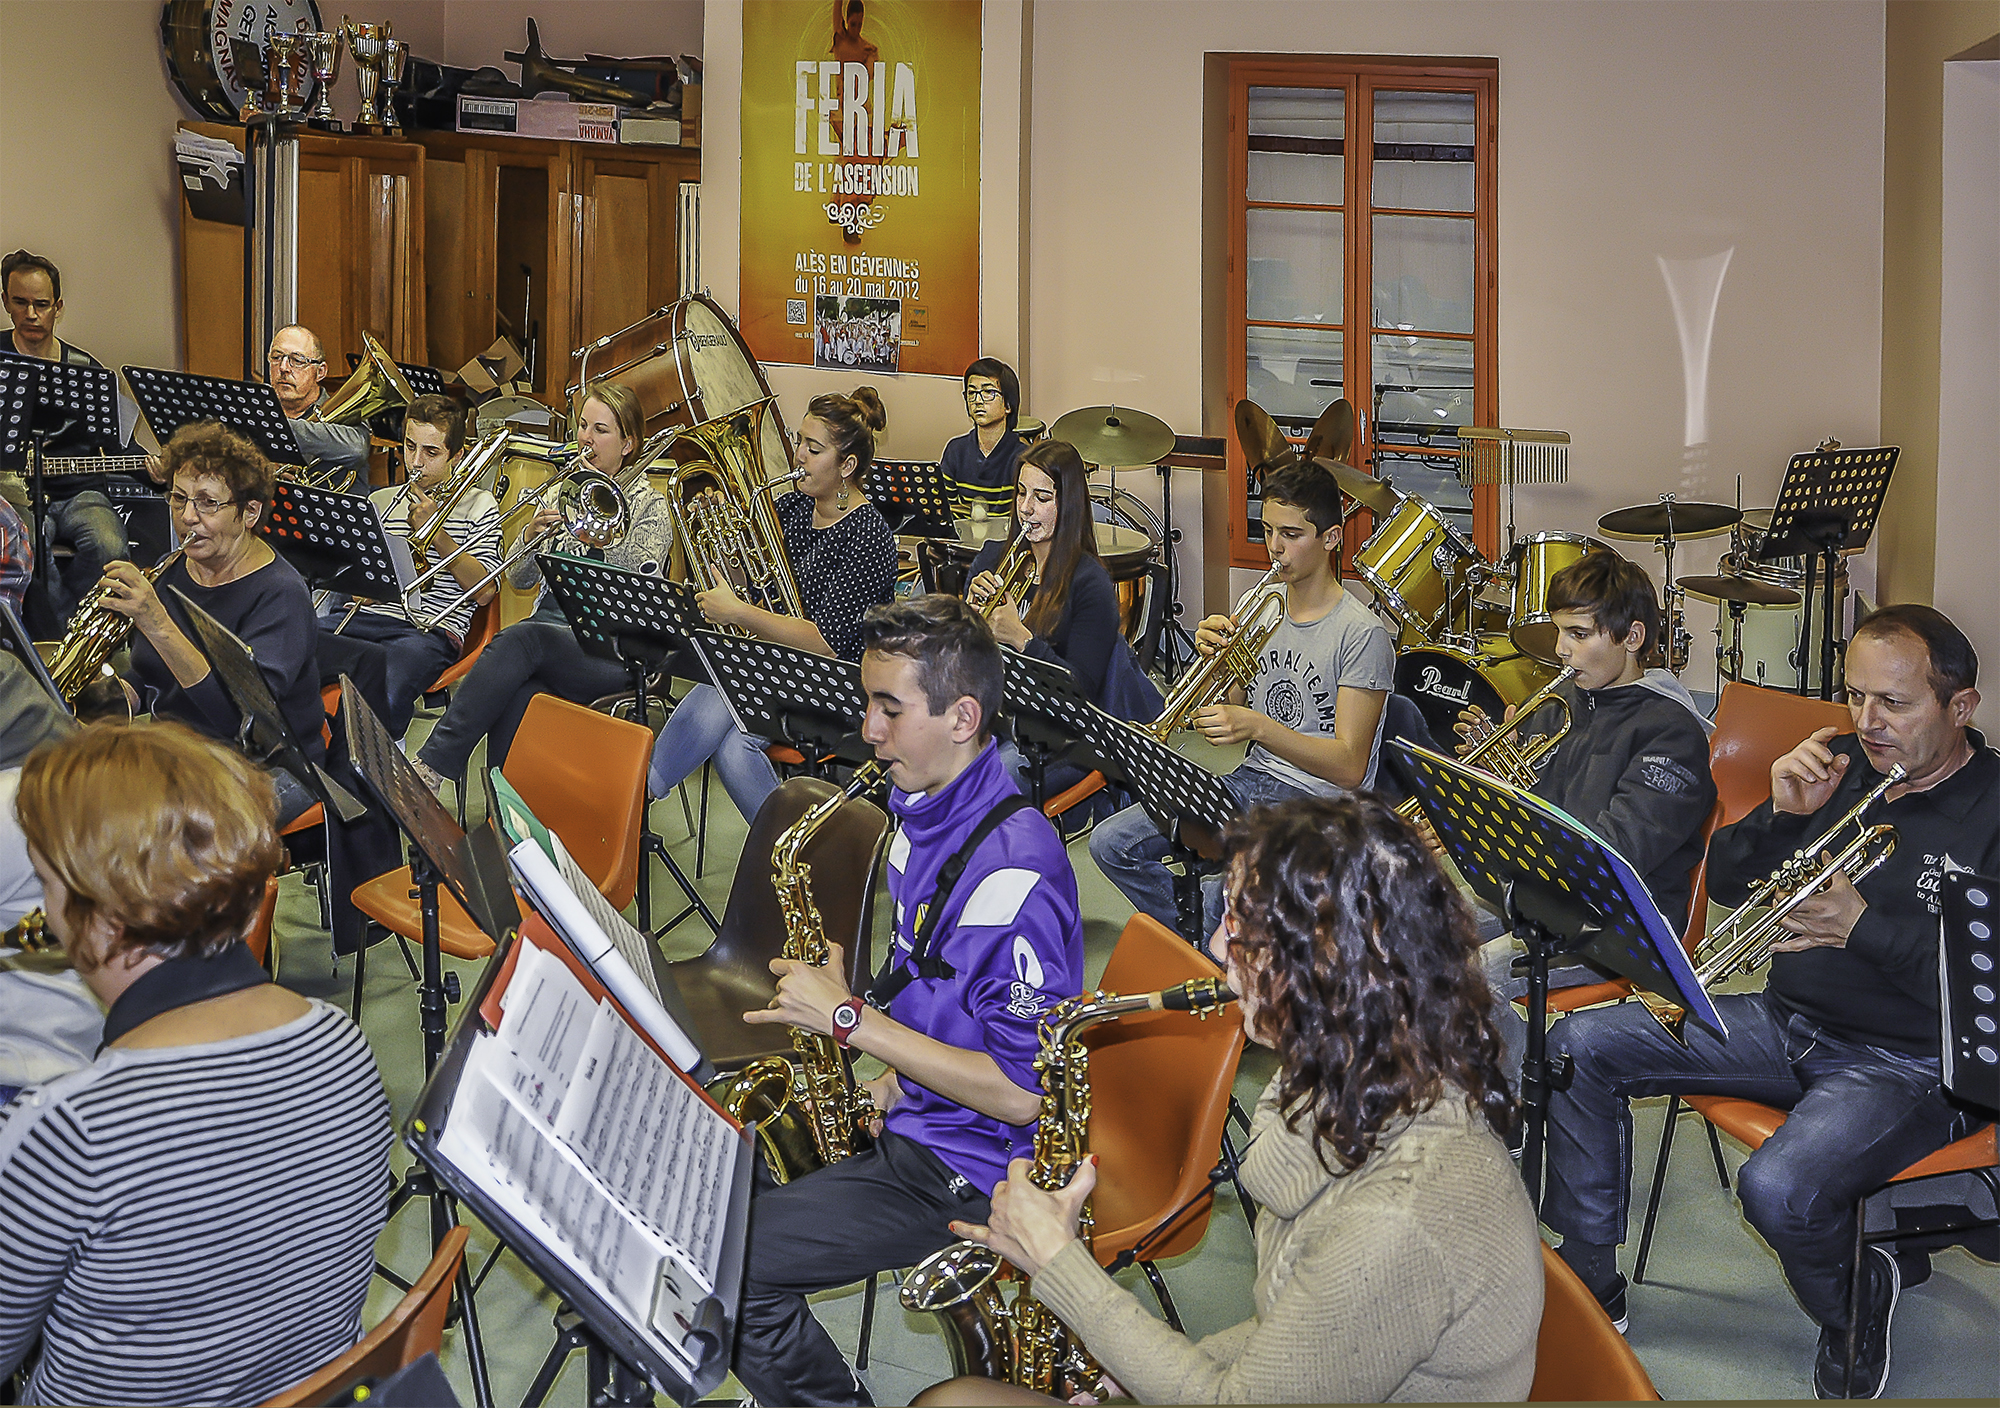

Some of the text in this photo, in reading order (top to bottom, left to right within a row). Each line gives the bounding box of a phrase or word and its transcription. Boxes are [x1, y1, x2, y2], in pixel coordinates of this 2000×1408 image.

[795, 61, 919, 157] FERIA
[578, 124, 614, 141] YAMAHA
[794, 162, 918, 197] DE L'ASCENSION
[795, 248, 919, 279] ALÈS EN CÉVENNES
[795, 274, 920, 300] du 16 au 20 mai 2012
[1302, 661, 1336, 734] TEAMS
[1413, 666, 1472, 700] Pearl
[1648, 764, 1688, 791] SEVENTY
